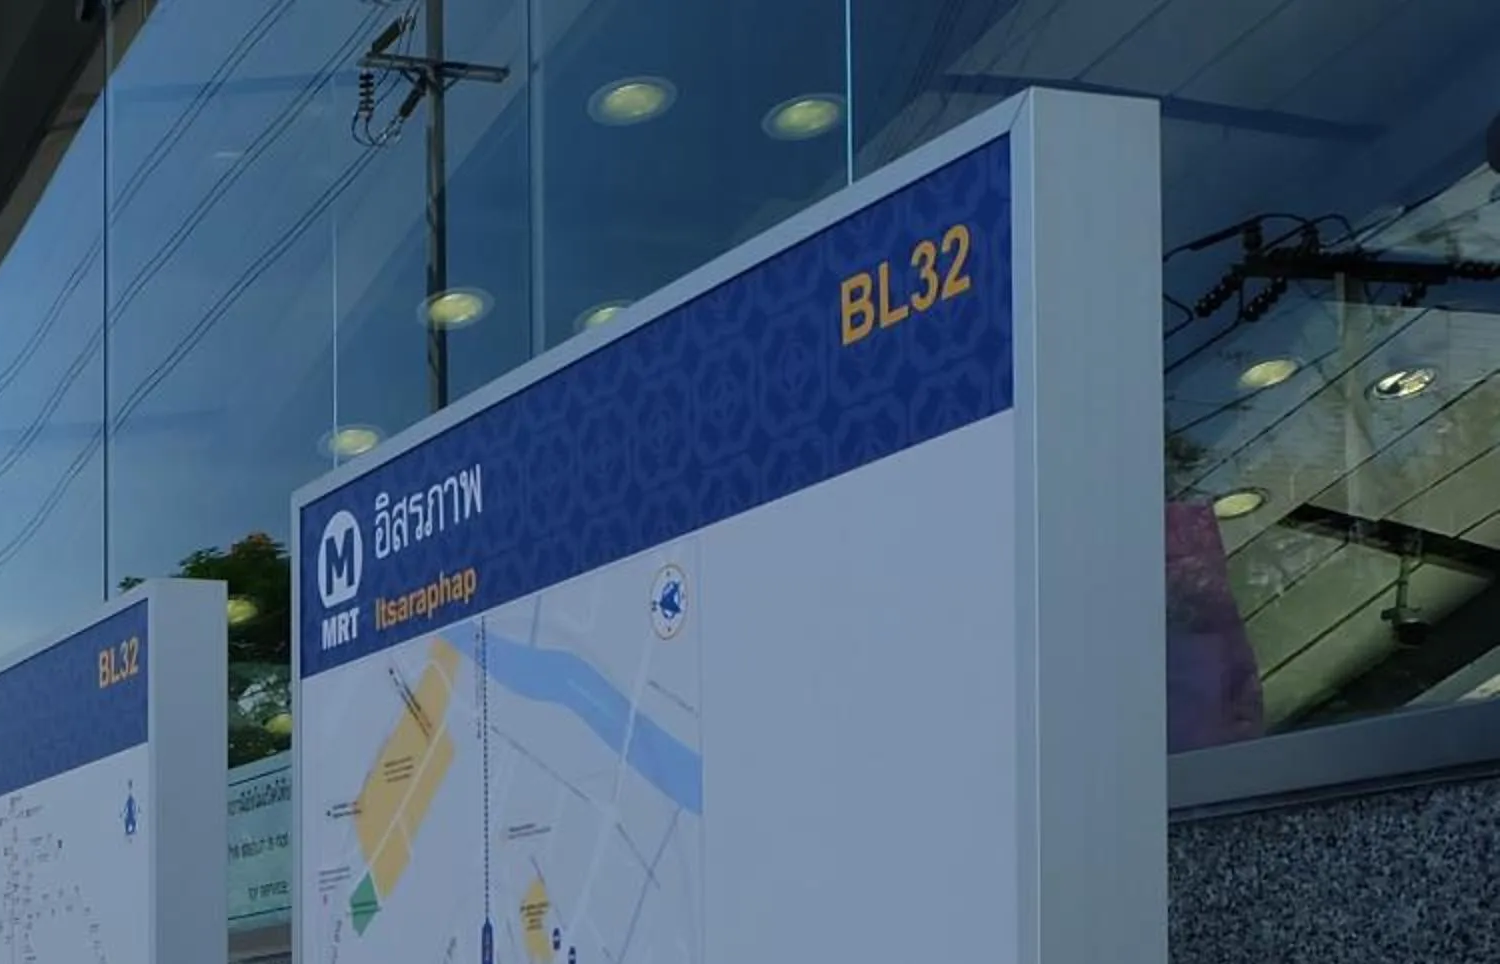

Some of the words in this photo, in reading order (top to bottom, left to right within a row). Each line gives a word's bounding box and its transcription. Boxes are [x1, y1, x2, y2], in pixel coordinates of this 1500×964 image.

[840, 224, 971, 346] BL32
[375, 463, 483, 560] อิสรภาพ
[322, 607, 360, 651] MRT
[375, 566, 478, 631] Itsaraphap
[99, 636, 139, 688] BL32
